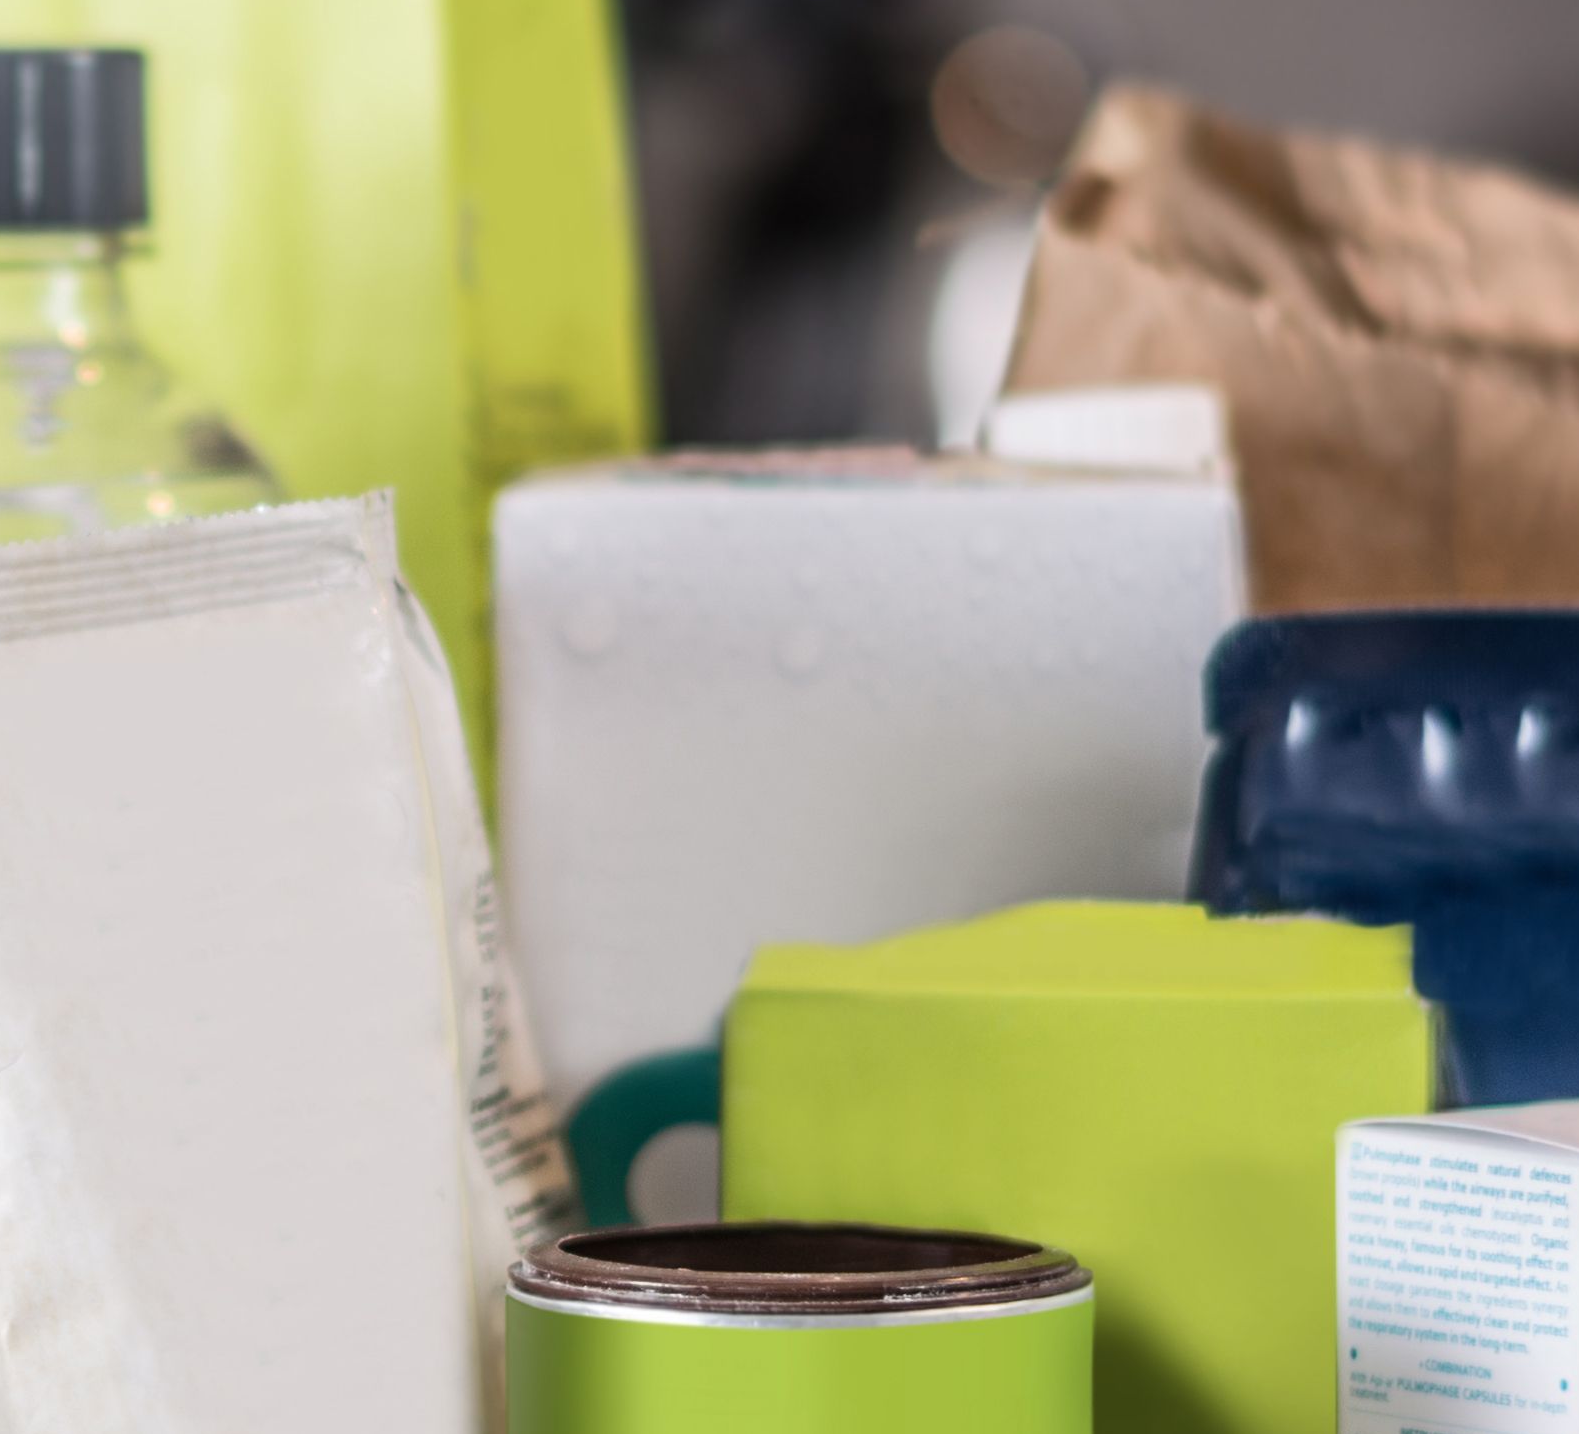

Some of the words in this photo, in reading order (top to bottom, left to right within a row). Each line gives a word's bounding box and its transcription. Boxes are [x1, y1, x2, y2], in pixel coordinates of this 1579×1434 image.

[1487, 1165, 1521, 1177] natural
[1529, 1169, 1571, 1183] defences
[1423, 1178, 1447, 1190] while
[1451, 1181, 1466, 1193] the
[1508, 1189, 1523, 1200] are
[1393, 1195, 1410, 1207] and
[1418, 1200, 1481, 1216] strengthened
[1531, 1234, 1568, 1250] Organic
[1411, 1241, 1445, 1255] famous
[1448, 1244, 1461, 1257] for
[1480, 1251, 1521, 1269] soothing
[1525, 1255, 1552, 1268] effect
[1460, 1270, 1477, 1281] and
[1479, 1273, 1520, 1287] targeted
[1433, 1307, 1481, 1324] effectively
[1512, 1321, 1529, 1332] and
[1460, 1334, 1476, 1346] the
[1462, 1389, 1510, 1405] CAPSULES
